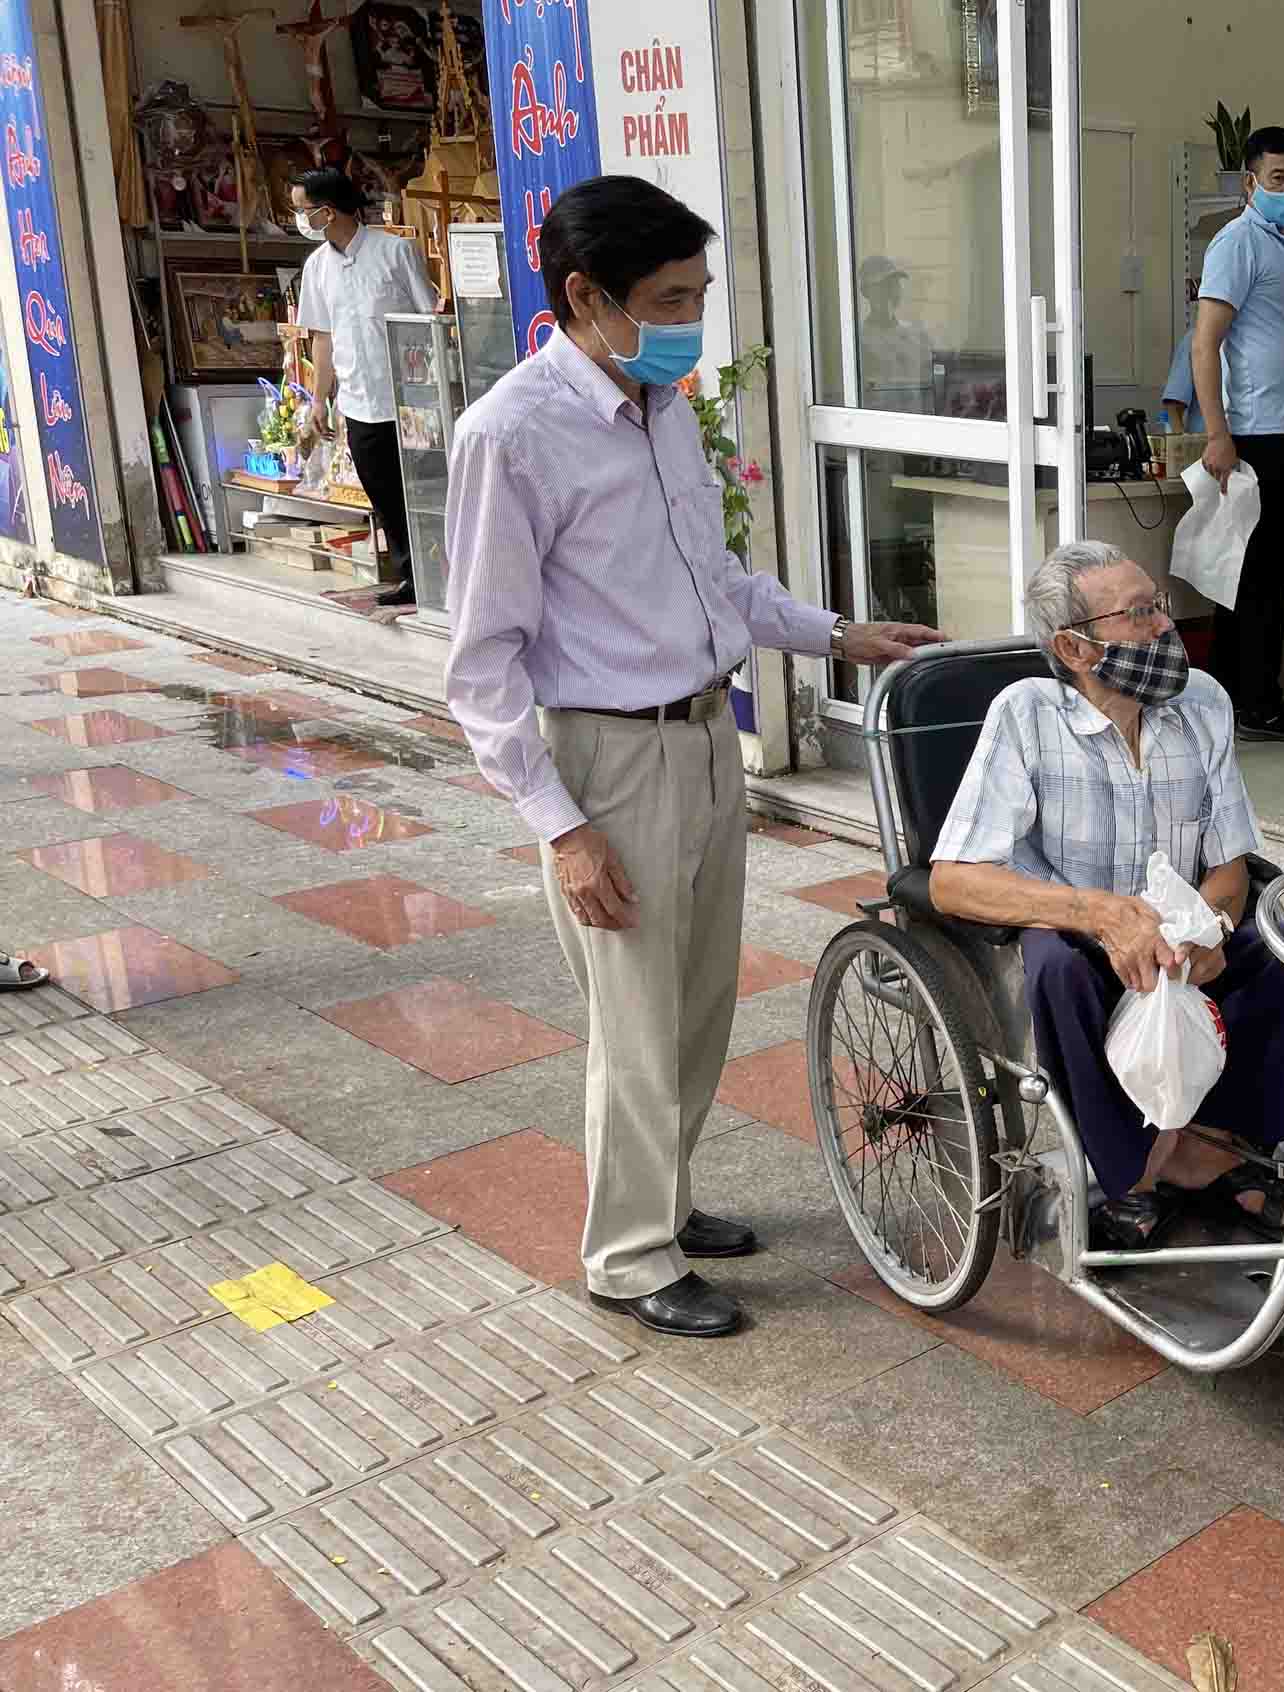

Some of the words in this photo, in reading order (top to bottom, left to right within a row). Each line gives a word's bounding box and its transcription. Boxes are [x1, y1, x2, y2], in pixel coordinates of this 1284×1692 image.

[620, 38, 683, 93] CHÂN
[512, 44, 578, 160] Ảnh
[623, 95, 691, 157] PHẨM
